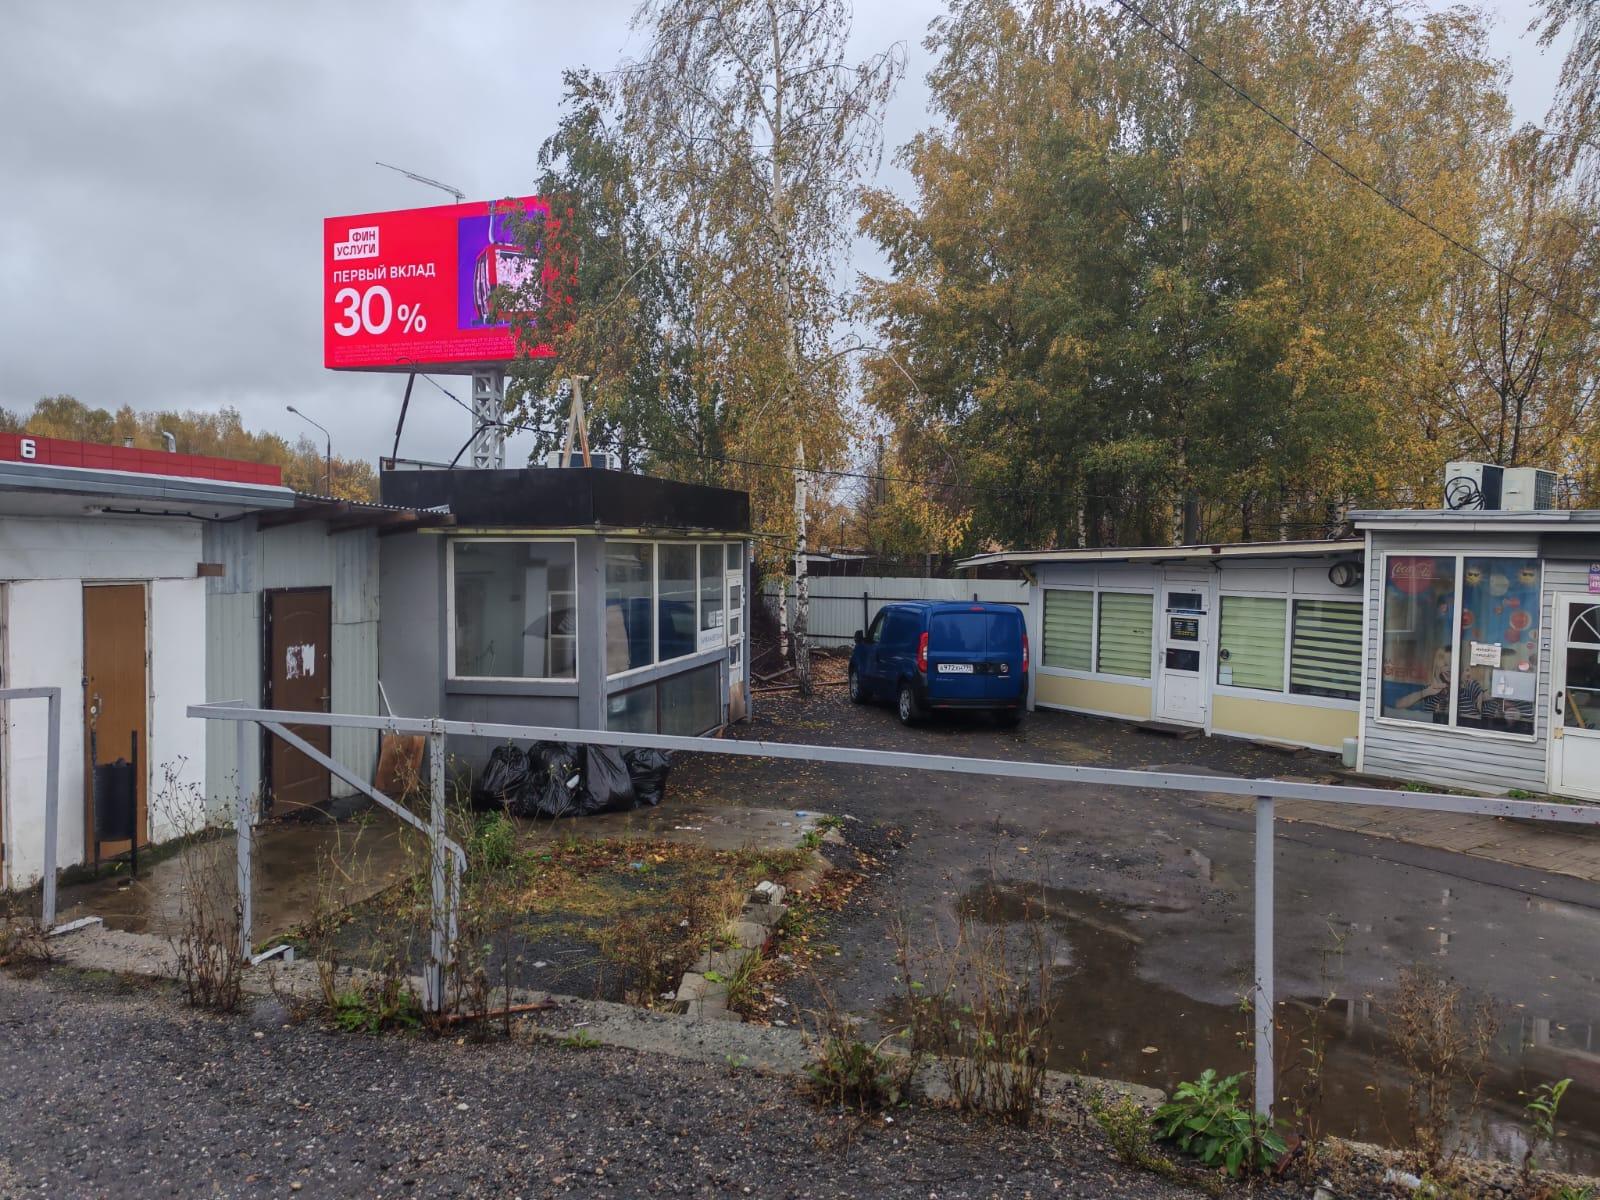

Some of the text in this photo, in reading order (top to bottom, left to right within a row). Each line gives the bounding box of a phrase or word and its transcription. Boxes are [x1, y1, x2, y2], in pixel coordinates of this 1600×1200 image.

[352, 230, 376, 242] ФИН
[336, 244, 376, 257] УСЛУГИ
[333, 263, 436, 283] ПЕРВЫЙ ВКЛАД
[333, 285, 427, 337] 30 %
[20, 438, 36, 459] 6
